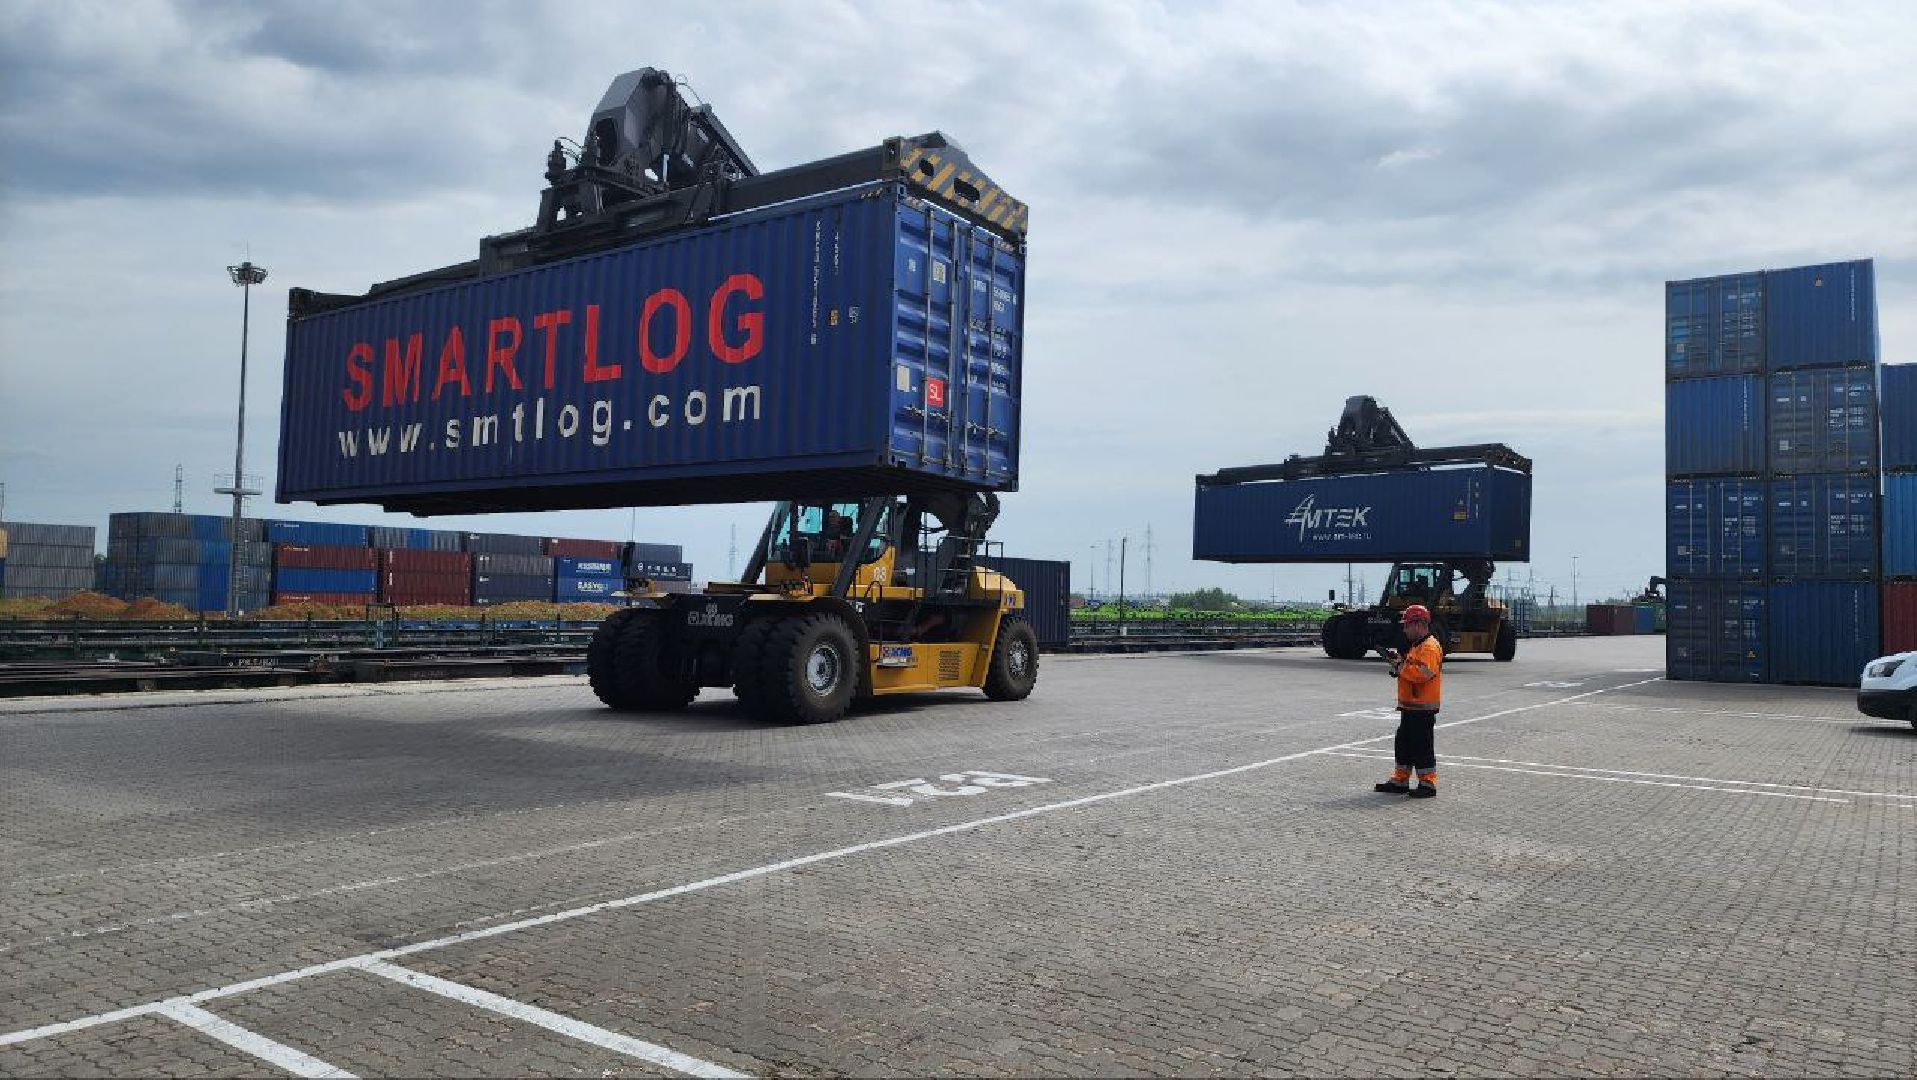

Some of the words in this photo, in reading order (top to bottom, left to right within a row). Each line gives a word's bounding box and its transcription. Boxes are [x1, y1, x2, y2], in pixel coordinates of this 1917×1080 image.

[343, 273, 763, 412] SMARTLOG
[338, 385, 761, 459] www.smtlog.com
[1284, 493, 1372, 542] AMTEK
